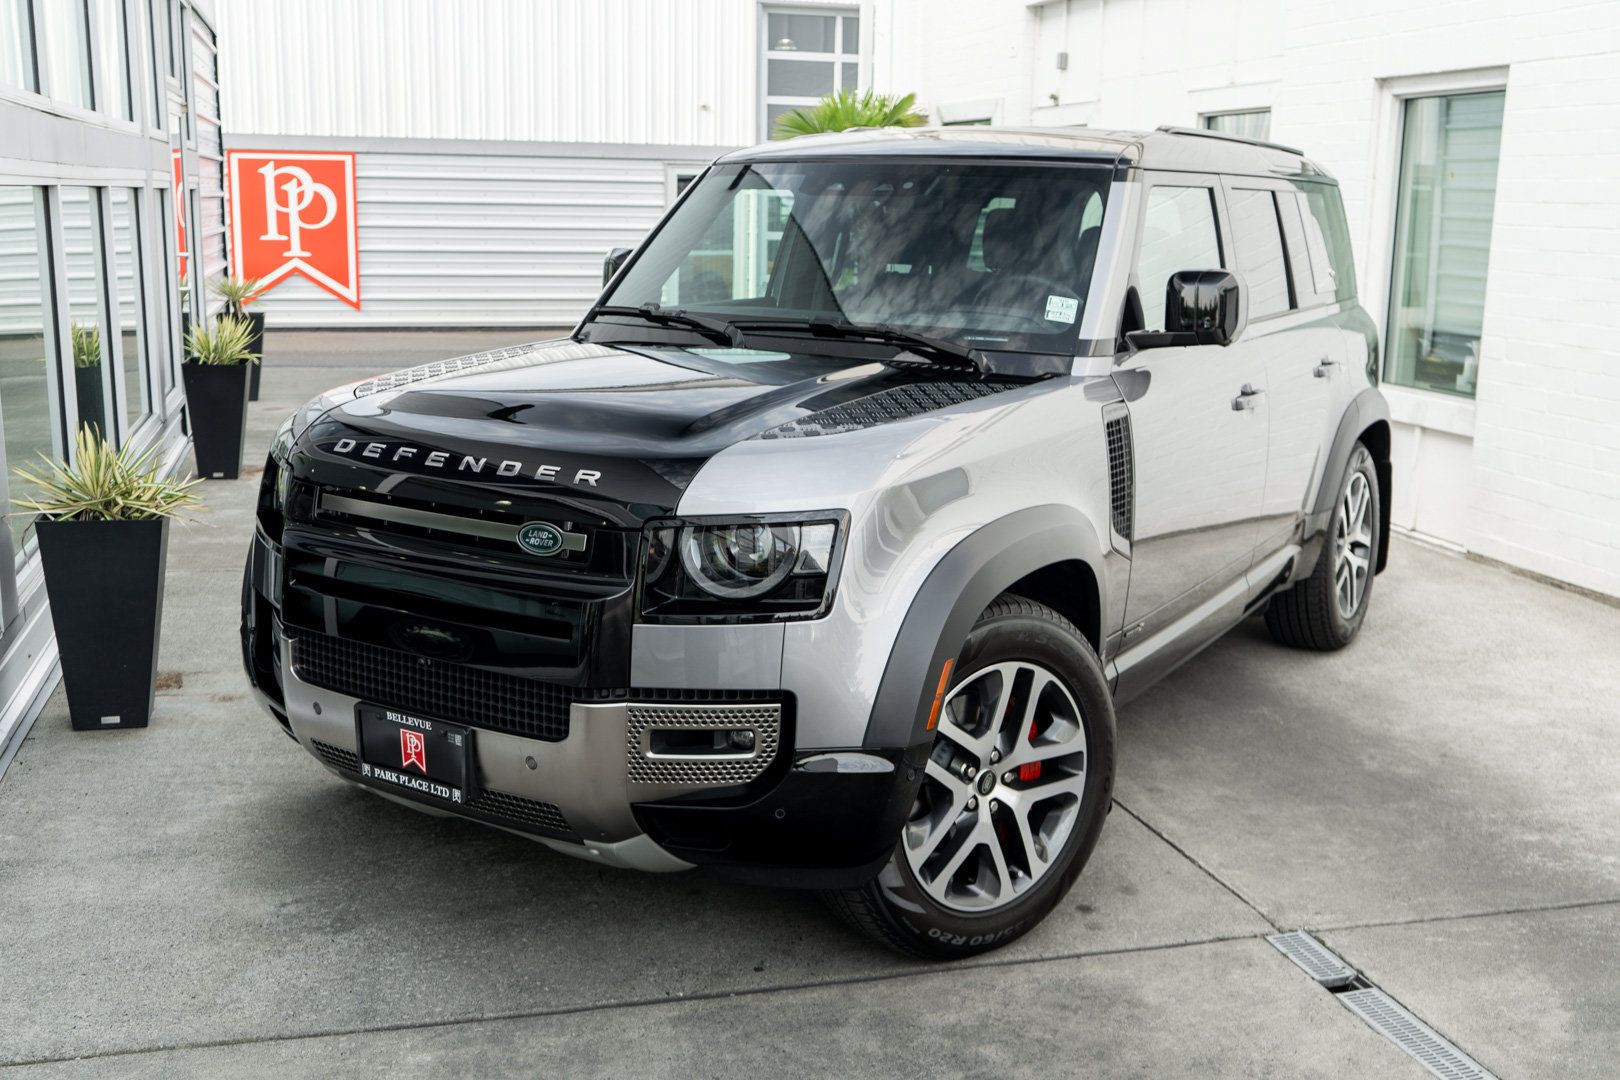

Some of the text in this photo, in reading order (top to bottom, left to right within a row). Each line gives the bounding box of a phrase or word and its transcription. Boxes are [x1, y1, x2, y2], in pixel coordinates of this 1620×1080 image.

[333, 438, 601, 487] DEFENDER
[386, 711, 432, 731] BELLEVUE
[374, 768, 398, 783] PARK
[399, 775, 429, 792] PLACE
[430, 783, 450, 798] LTD
[927, 927, 968, 946] R20
